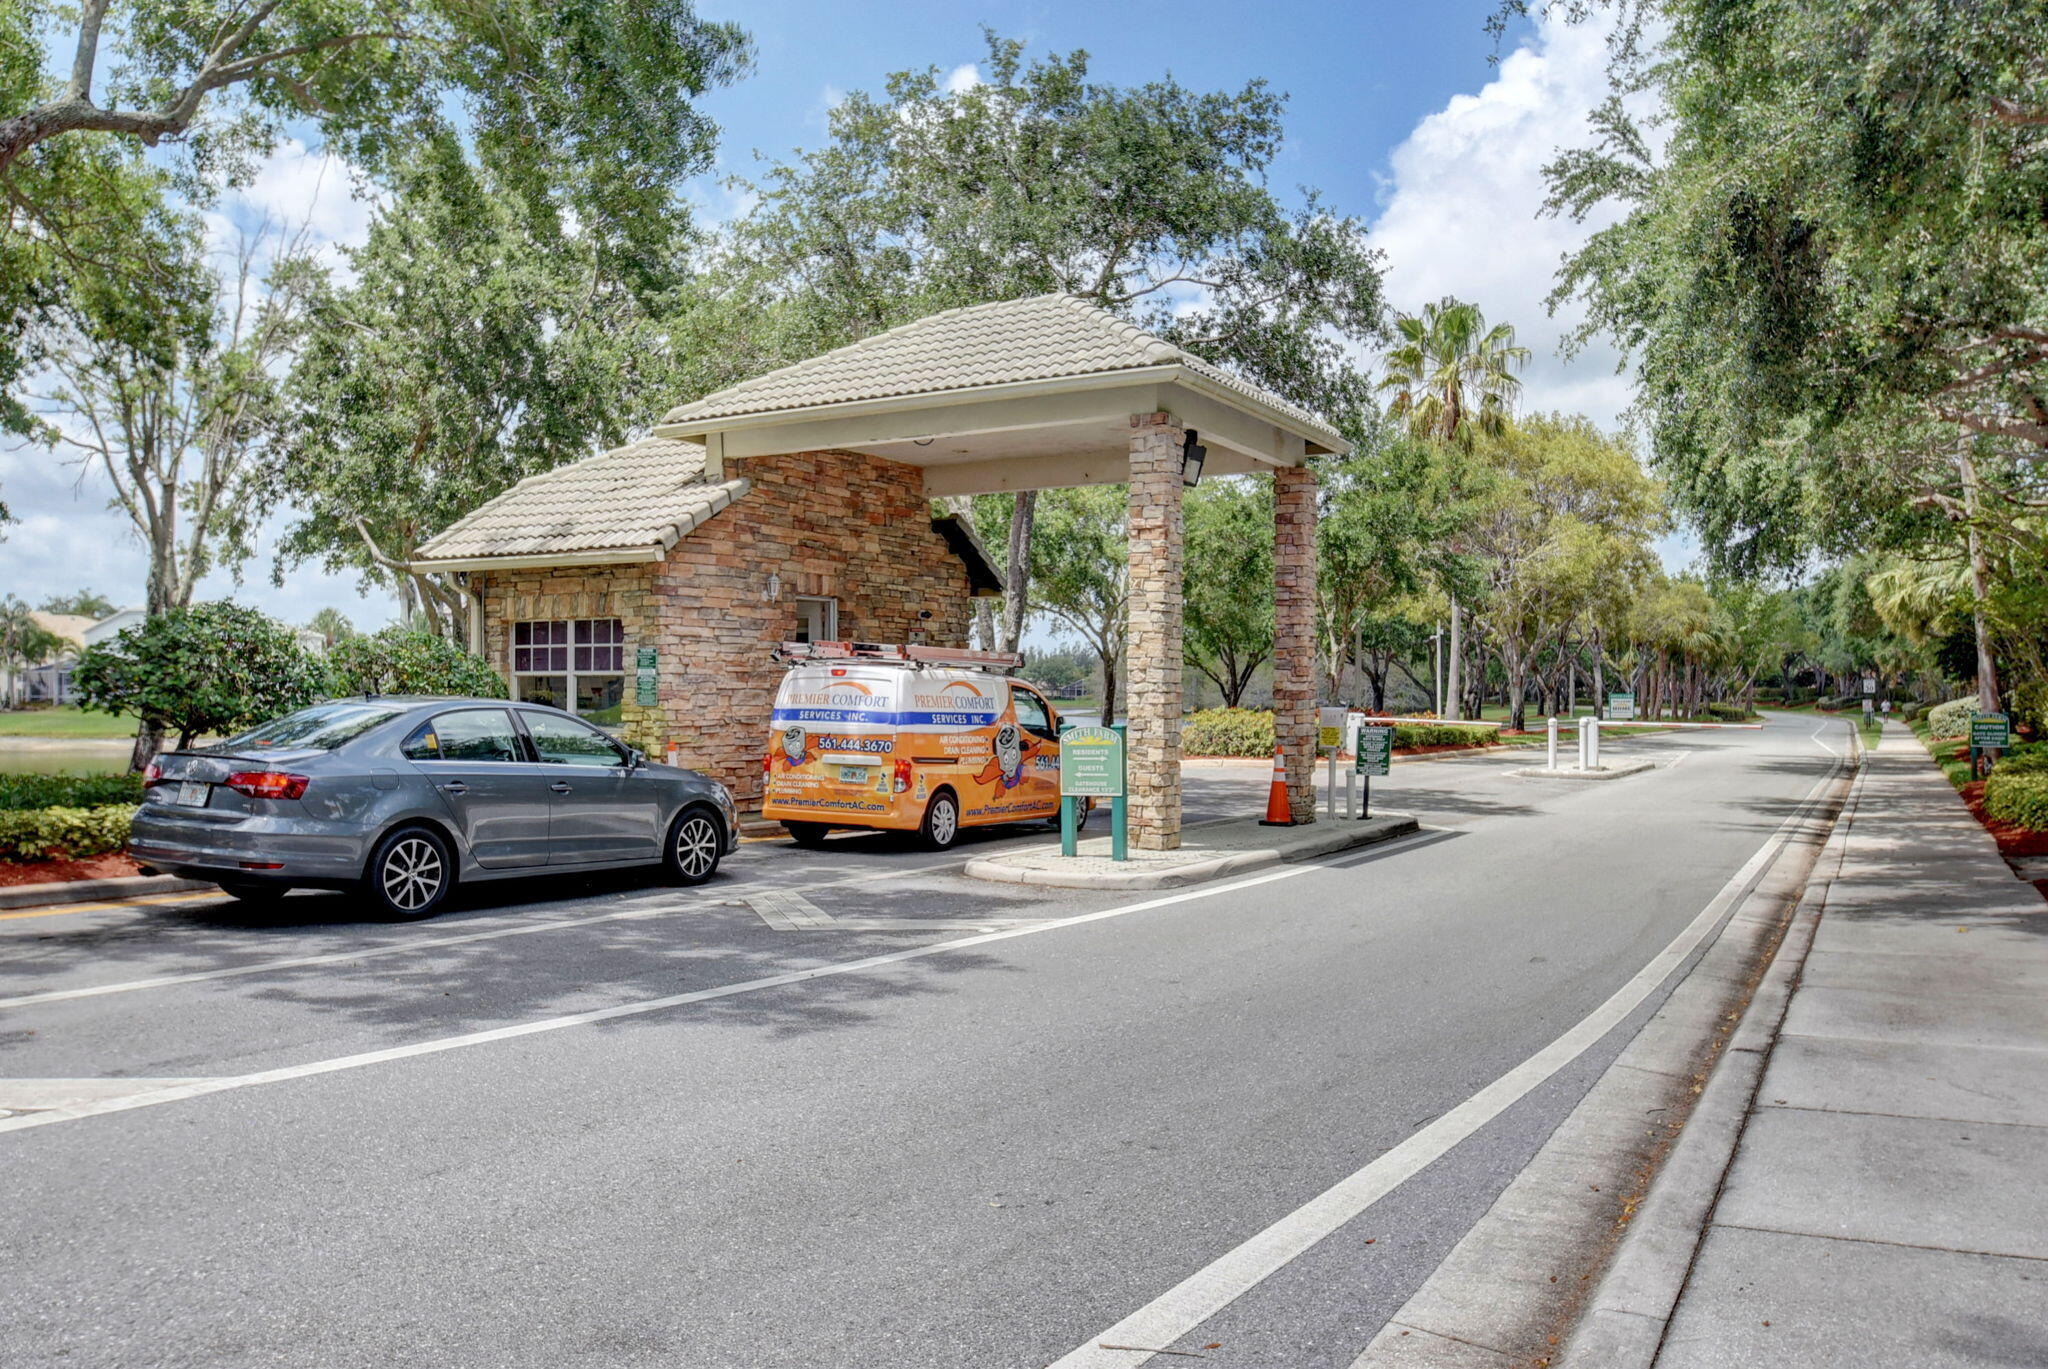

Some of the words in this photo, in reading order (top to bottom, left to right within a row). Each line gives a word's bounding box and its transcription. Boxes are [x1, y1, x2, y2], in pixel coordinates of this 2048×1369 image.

[787, 693, 830, 705] PREMIER
[832, 694, 889, 707] COMFORT
[914, 694, 954, 708] PREMIER
[955, 696, 994, 709] COMFORT
[800, 710, 841, 720] SERVICES
[848, 712, 868, 722] INC.
[932, 714, 967, 724] SERVICES
[971, 715, 986, 724] INC.
[1063, 728, 1090, 743] SMITH
[818, 737, 892, 753] 561.444.3670
[772, 796, 884, 811] www.PremierComfortAC.com
